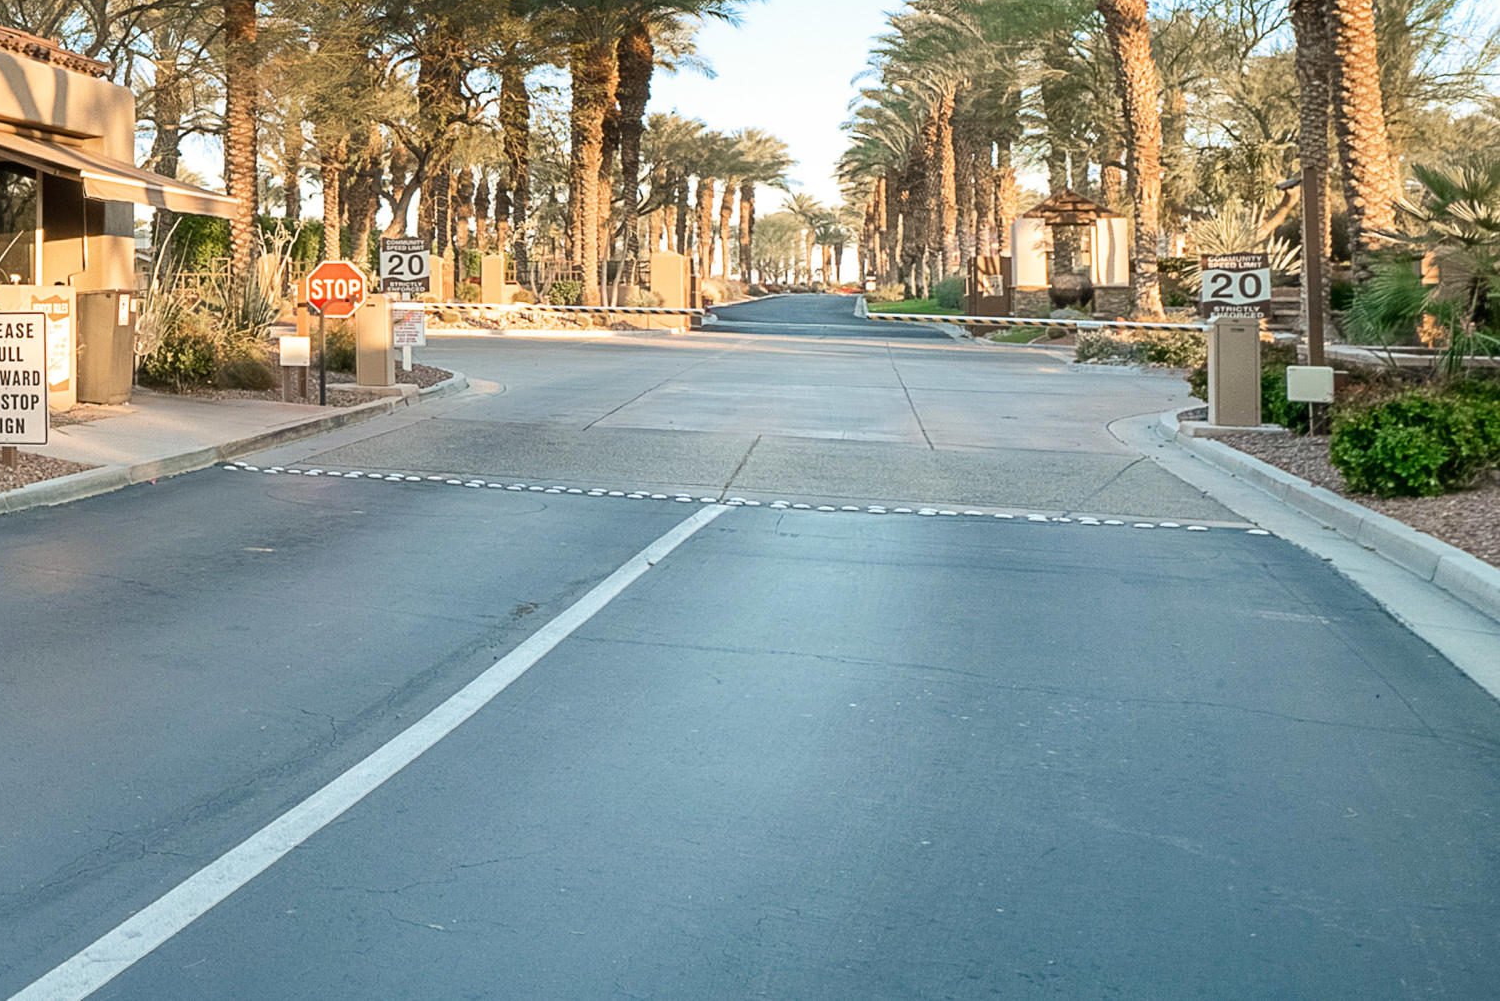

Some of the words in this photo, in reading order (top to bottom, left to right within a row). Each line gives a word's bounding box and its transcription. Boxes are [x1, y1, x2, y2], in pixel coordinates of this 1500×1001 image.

[388, 254, 424, 276] 20
[311, 278, 361, 300] STOP
[1210, 273, 1262, 299] 20
[1, 393, 39, 410] STOP
